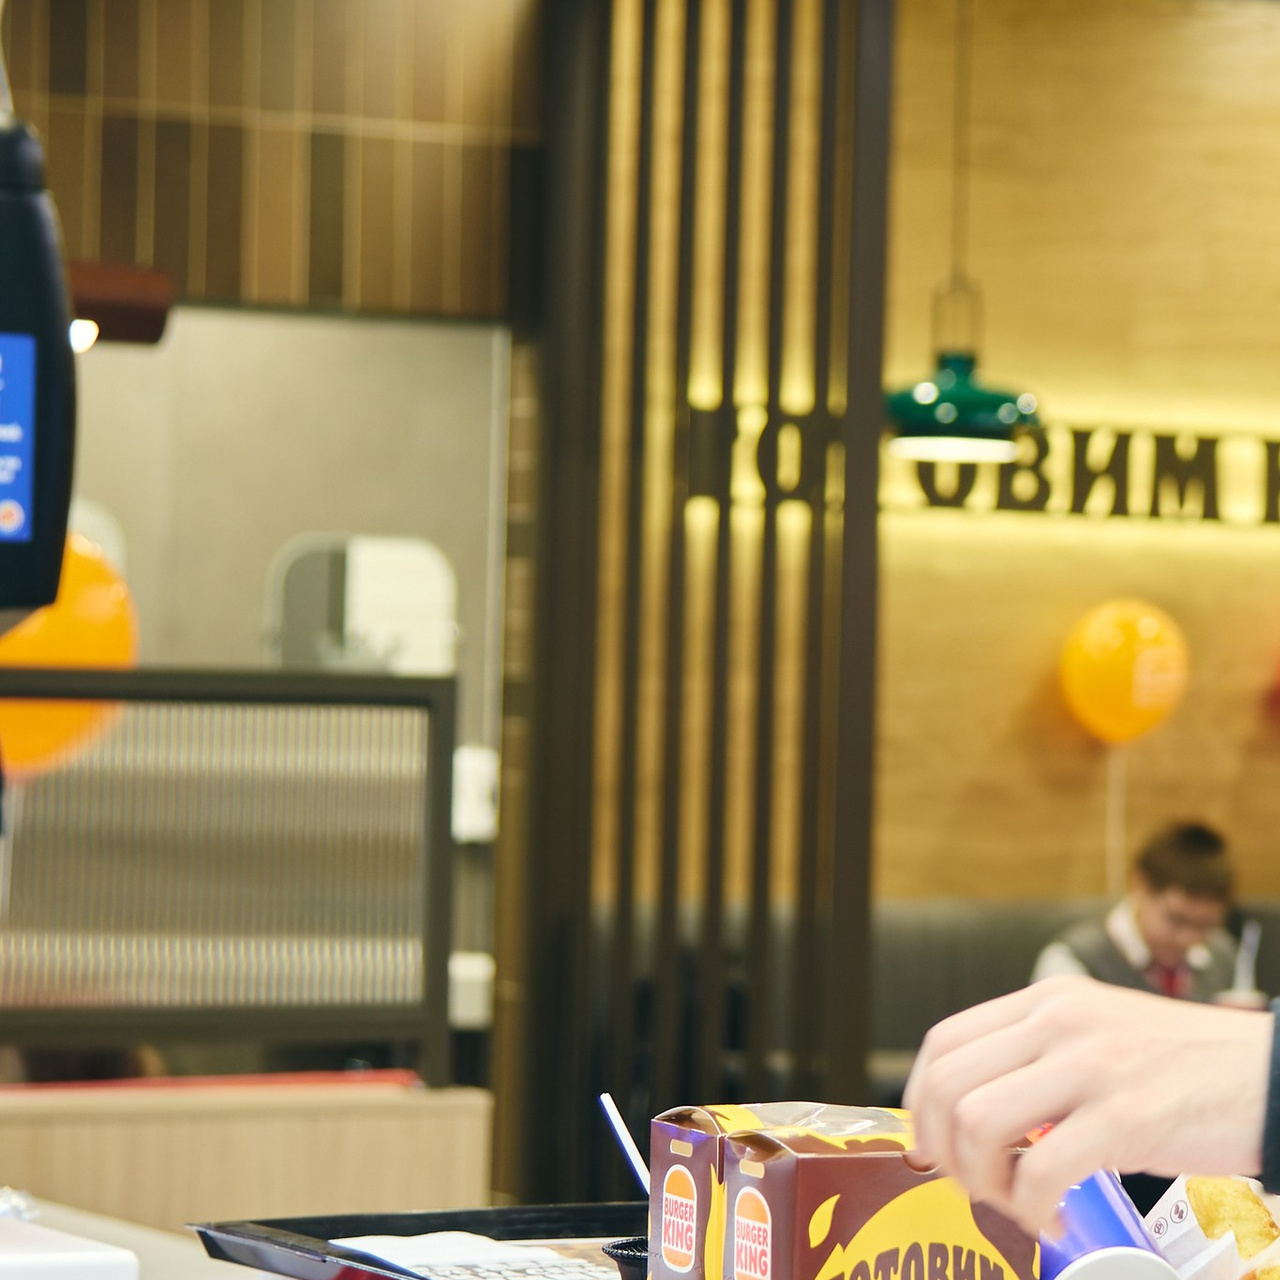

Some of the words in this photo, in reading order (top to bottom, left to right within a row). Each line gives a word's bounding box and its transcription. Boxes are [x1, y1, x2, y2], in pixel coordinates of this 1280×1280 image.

[664, 1195, 695, 1223] BURGER
[663, 1220, 694, 1252] KING
[736, 1219, 769, 1248] BURGER
[736, 1240, 769, 1277] KING
